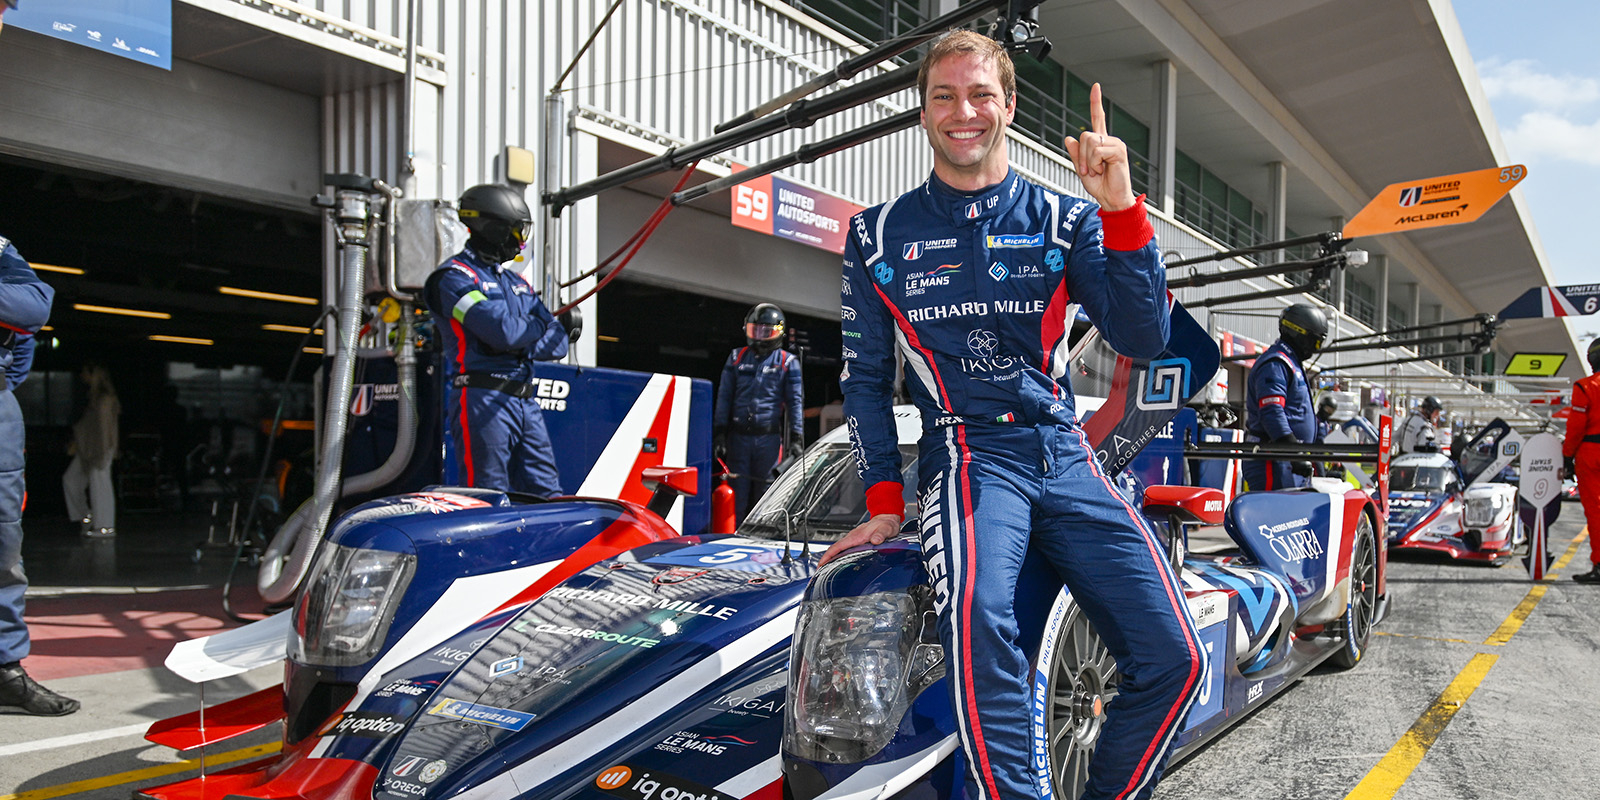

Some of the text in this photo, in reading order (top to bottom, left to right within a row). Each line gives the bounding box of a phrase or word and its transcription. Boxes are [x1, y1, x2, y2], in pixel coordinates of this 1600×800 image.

[1498, 166, 1523, 183] 59
[1424, 180, 1461, 191] UNITED
[736, 184, 769, 221] 59
[778, 187, 815, 211] UNITED
[986, 195, 999, 209] UP
[776, 203, 840, 233] AUTOSPORTS
[1062, 200, 1089, 231] HRX
[1394, 209, 1460, 226] McLaren
[854, 213, 873, 247] HRX
[925, 238, 958, 247] UNITED
[1003, 237, 1040, 245] MICHELIN
[906, 271, 924, 280] ASIAN
[1018, 265, 1039, 274] IPA
[905, 276, 950, 290] LE MANS
[905, 288, 926, 297] SERIES
[907, 300, 1045, 323] RICHARD MILLE
[1584, 297, 1598, 313] 6
[1529, 359, 1542, 370] 9
[374, 384, 399, 394] UNIT
[935, 416, 964, 426] HRX
[1114, 425, 1157, 470] TOGETHER
[1204, 500, 1223, 511] MOTUL
[1269, 529, 1324, 564] OLARRA
[699, 548, 765, 564] 5
[542, 586, 738, 621] RICHARD MILLE
[534, 623, 661, 649] CLEARROUTE
[1042, 600, 1066, 665] PILOT SPORT
[433, 646, 471, 661] IKIG
[536, 665, 567, 678] IPA
[383, 683, 427, 696] LE MANS
[1248, 680, 1264, 700] HRX
[713, 695, 786, 714] IKIGAI
[458, 708, 521, 724] MICHELIN
[350, 717, 405, 735] option
[673, 730, 700, 739] ASIAN
[1035, 681, 1050, 797] MICHELIN
[654, 743, 685, 754] SERIES
[662, 736, 728, 756] LE MANS
[391, 780, 429, 797] ORECA
[632, 773, 661, 800] iq
